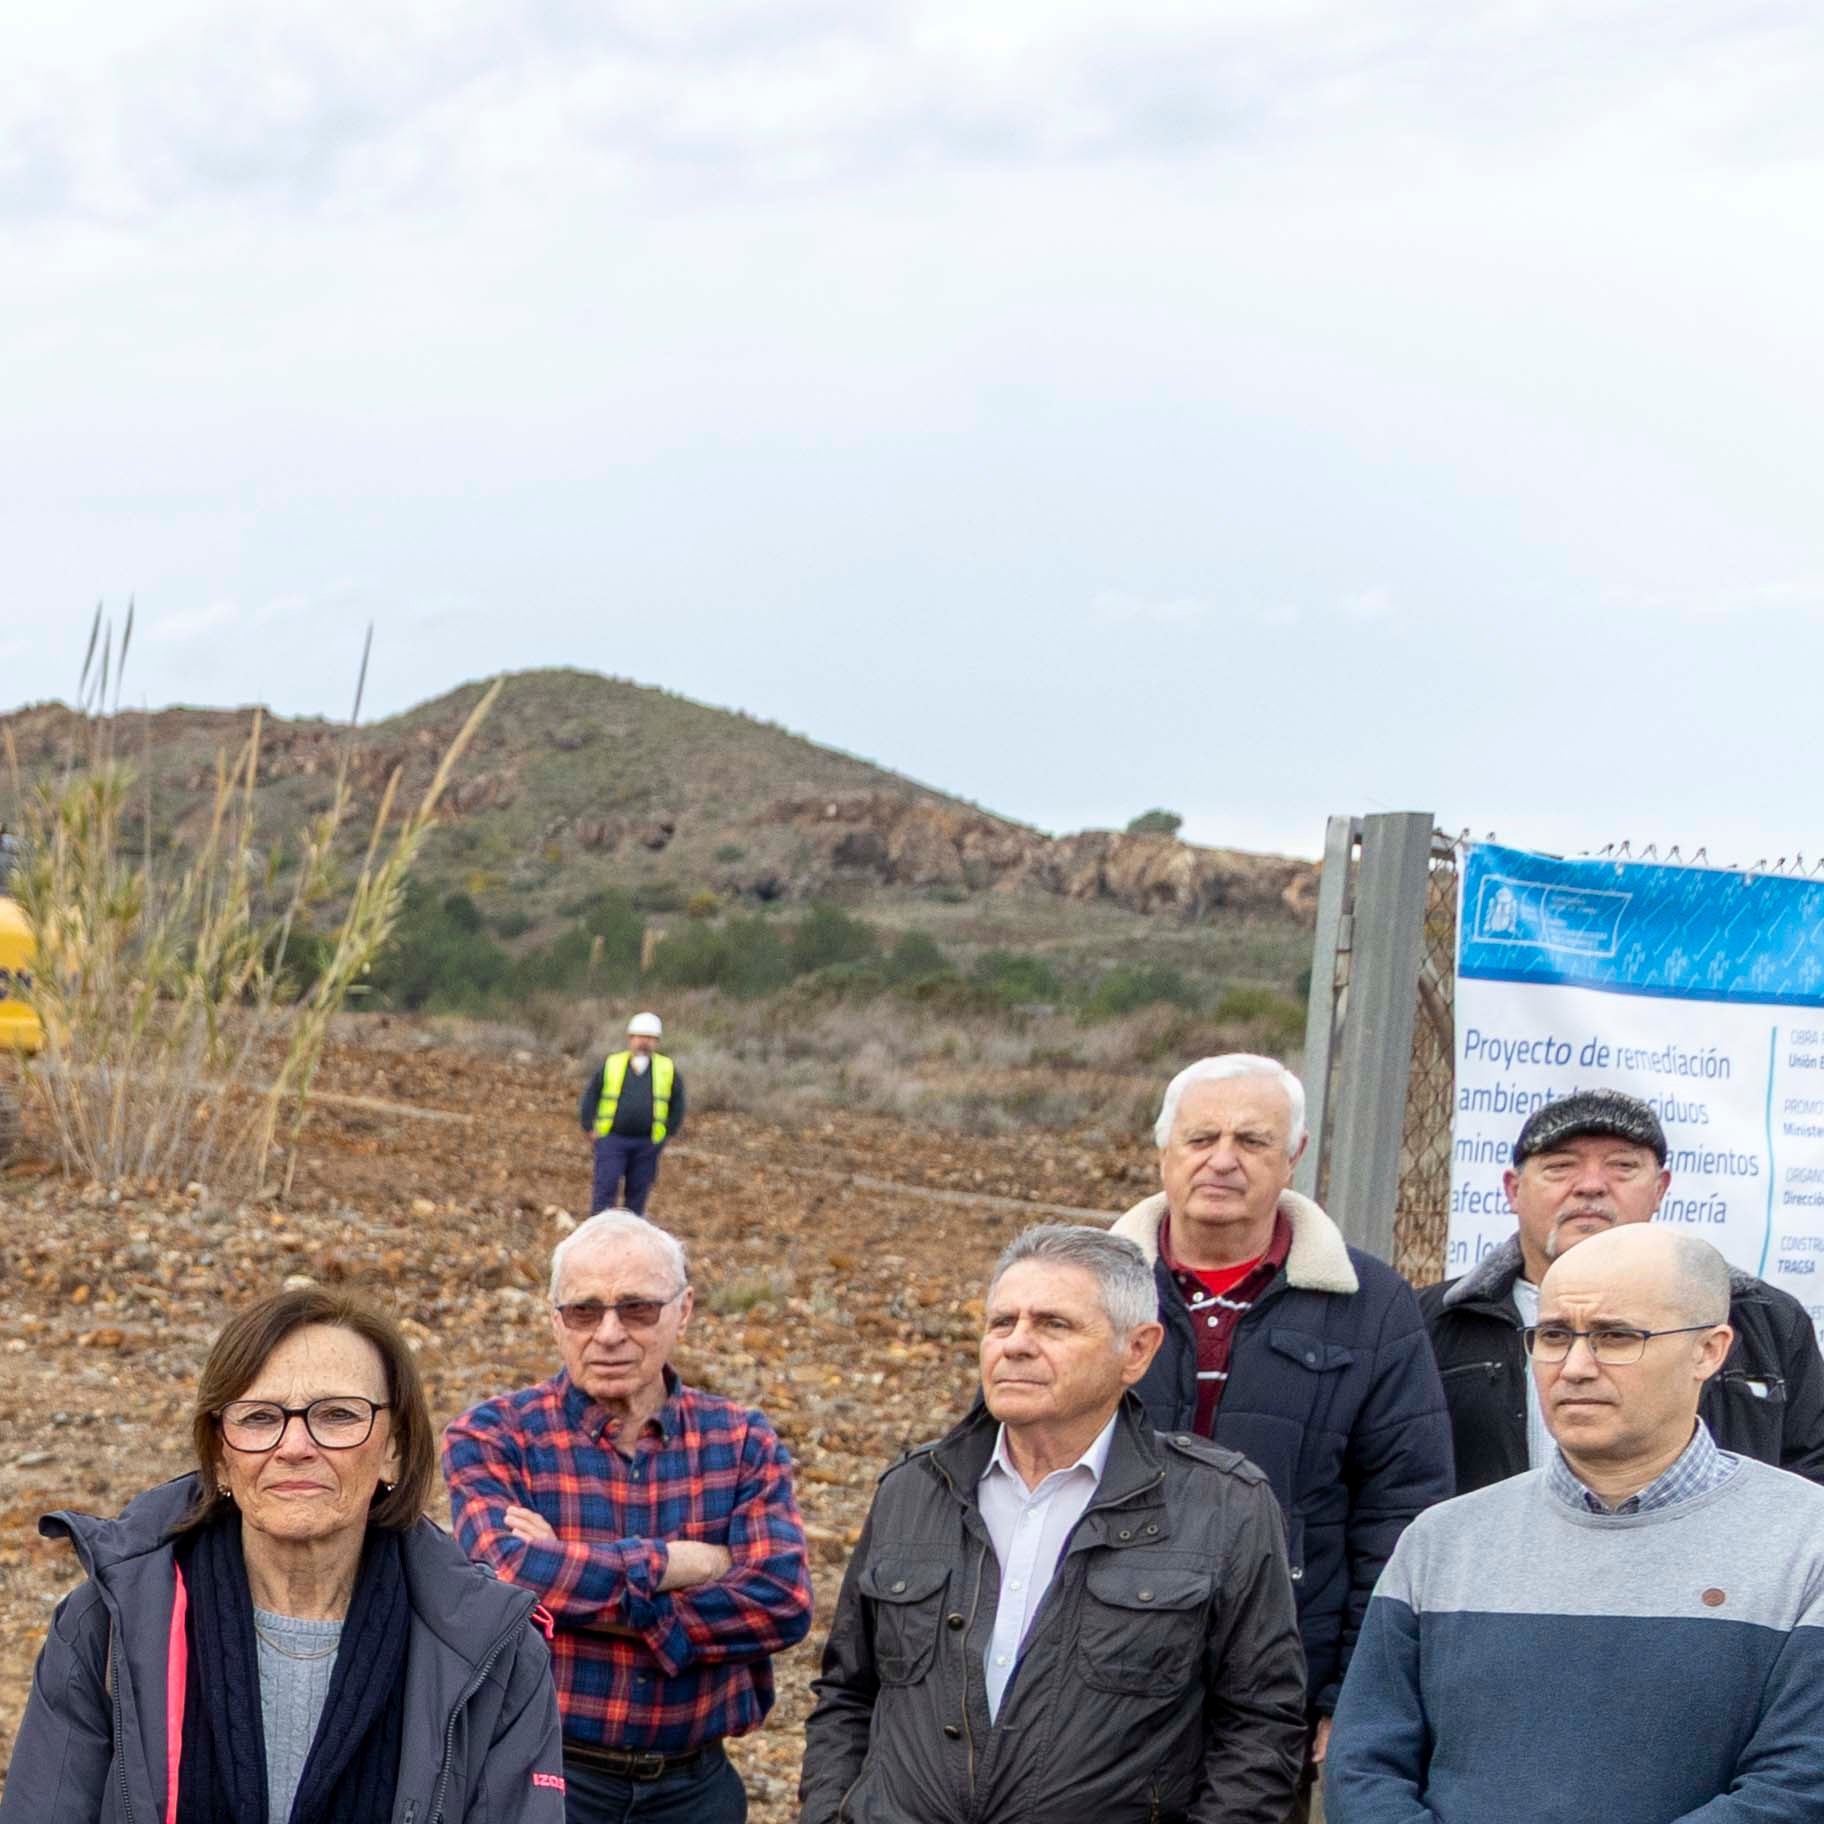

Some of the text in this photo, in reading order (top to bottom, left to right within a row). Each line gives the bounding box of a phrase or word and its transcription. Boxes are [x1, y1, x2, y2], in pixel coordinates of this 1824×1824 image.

[1464, 1029, 1732, 1079] Proyecto de remediación
[1789, 1053, 1818, 1069] Unión
[1458, 1081, 1579, 1115] ambient
[1784, 1099, 1824, 1116] PROMO
[1783, 1122, 1824, 1138] Ministe
[1665, 1143, 1760, 1177] amientos
[1652, 1192, 1728, 1224] inería
[1783, 1190, 1824, 1208] Direcció
[1448, 1240, 1468, 1264] en
